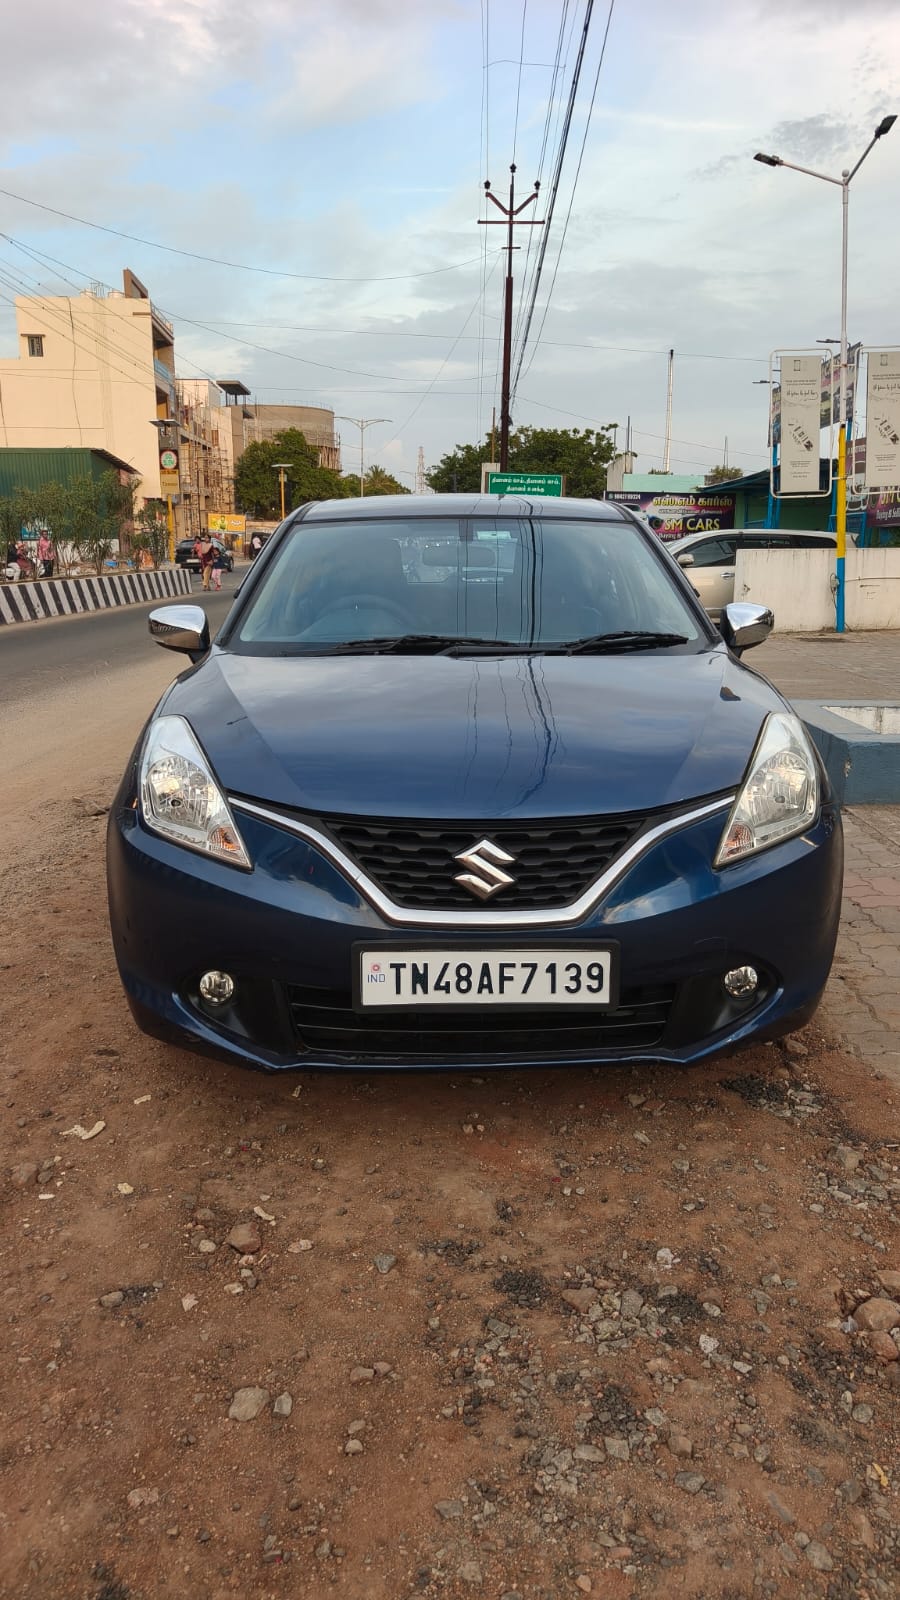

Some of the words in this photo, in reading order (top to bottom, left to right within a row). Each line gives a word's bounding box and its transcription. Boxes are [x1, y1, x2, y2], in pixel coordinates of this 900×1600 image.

[664, 518, 683, 531] SM
[686, 518, 720, 531] CARS
[367, 974, 386, 983] IND
[389, 962, 604, 995] TN48AF7139
